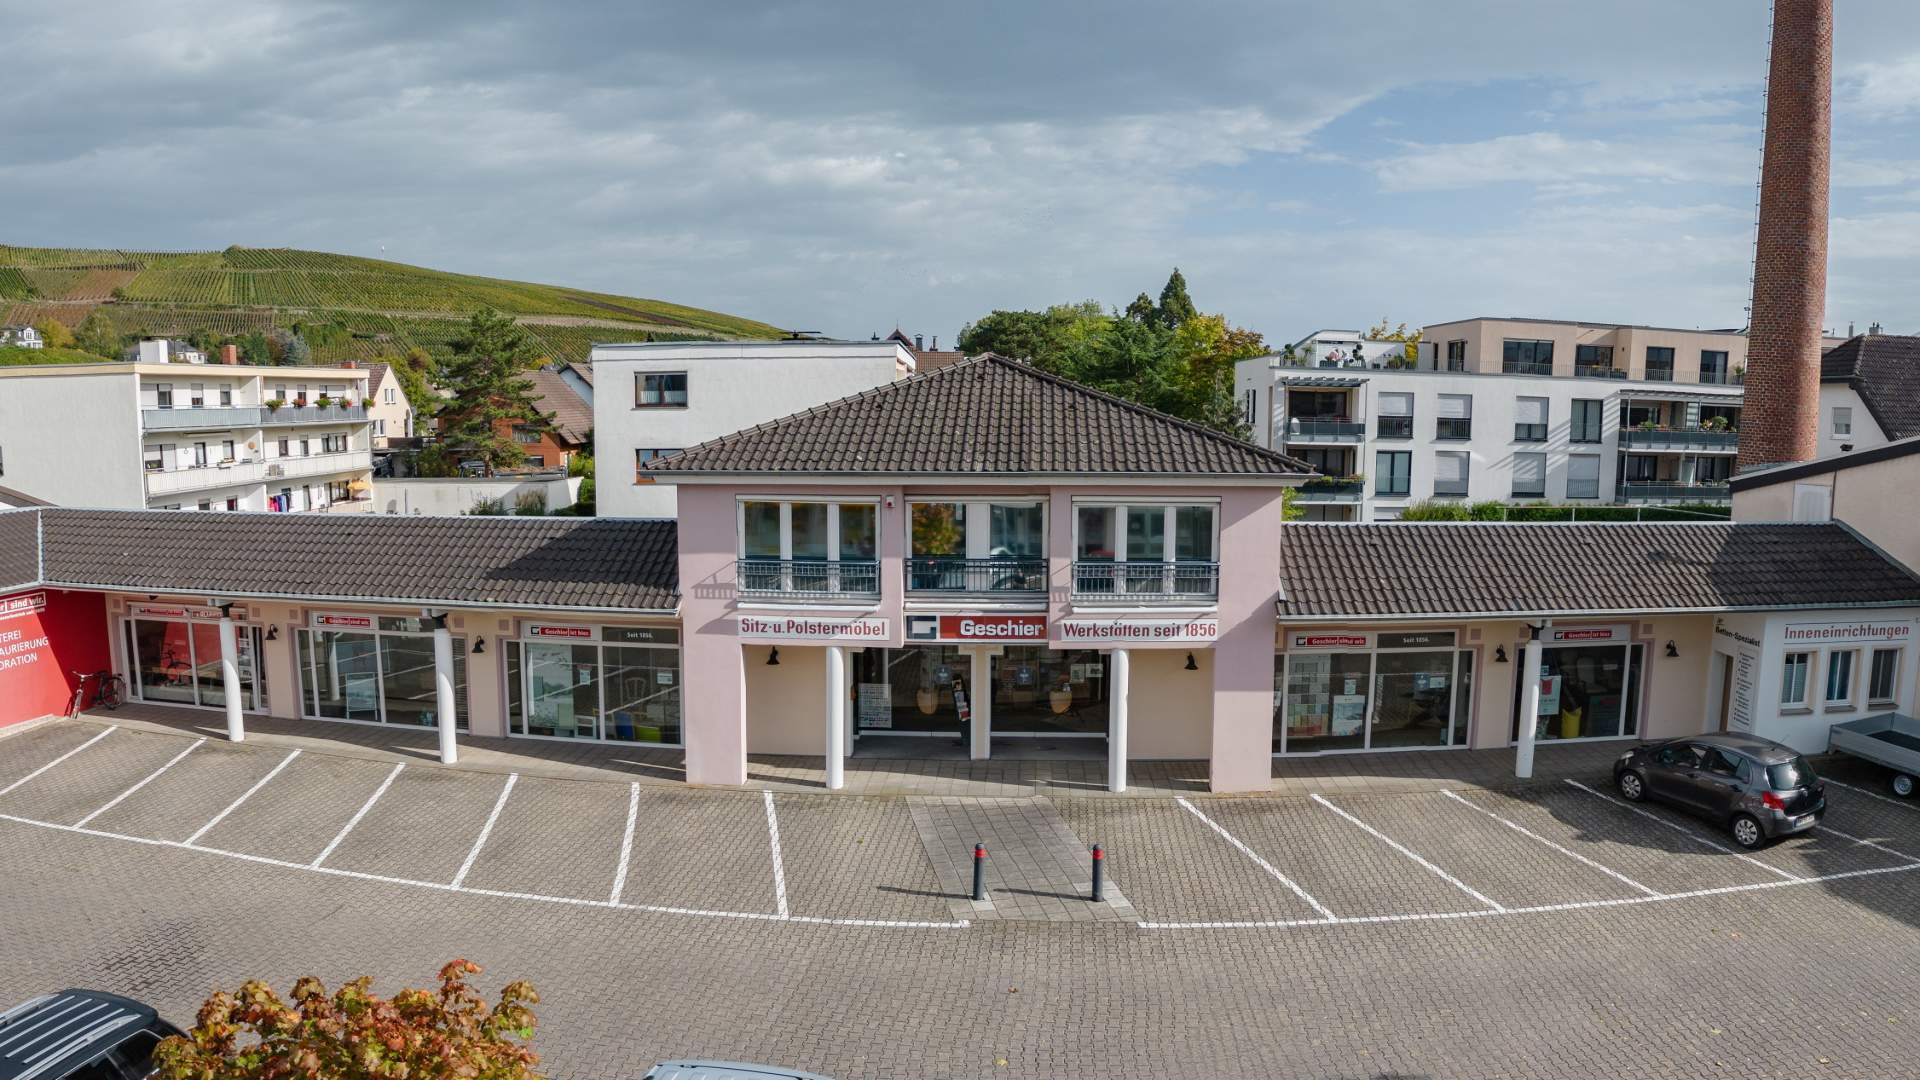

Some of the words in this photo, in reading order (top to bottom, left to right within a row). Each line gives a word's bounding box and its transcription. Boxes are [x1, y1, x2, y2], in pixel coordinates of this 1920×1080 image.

[10, 597, 28, 610] sind
[786, 620, 885, 636] Polstermöbel
[960, 619, 1044, 636] Geschier
[1063, 623, 1150, 638] Werkstätten
[1154, 623, 1181, 637] seit
[1184, 623, 1217, 637] 1856
[1784, 624, 1910, 640] Inneneinrichtungen
